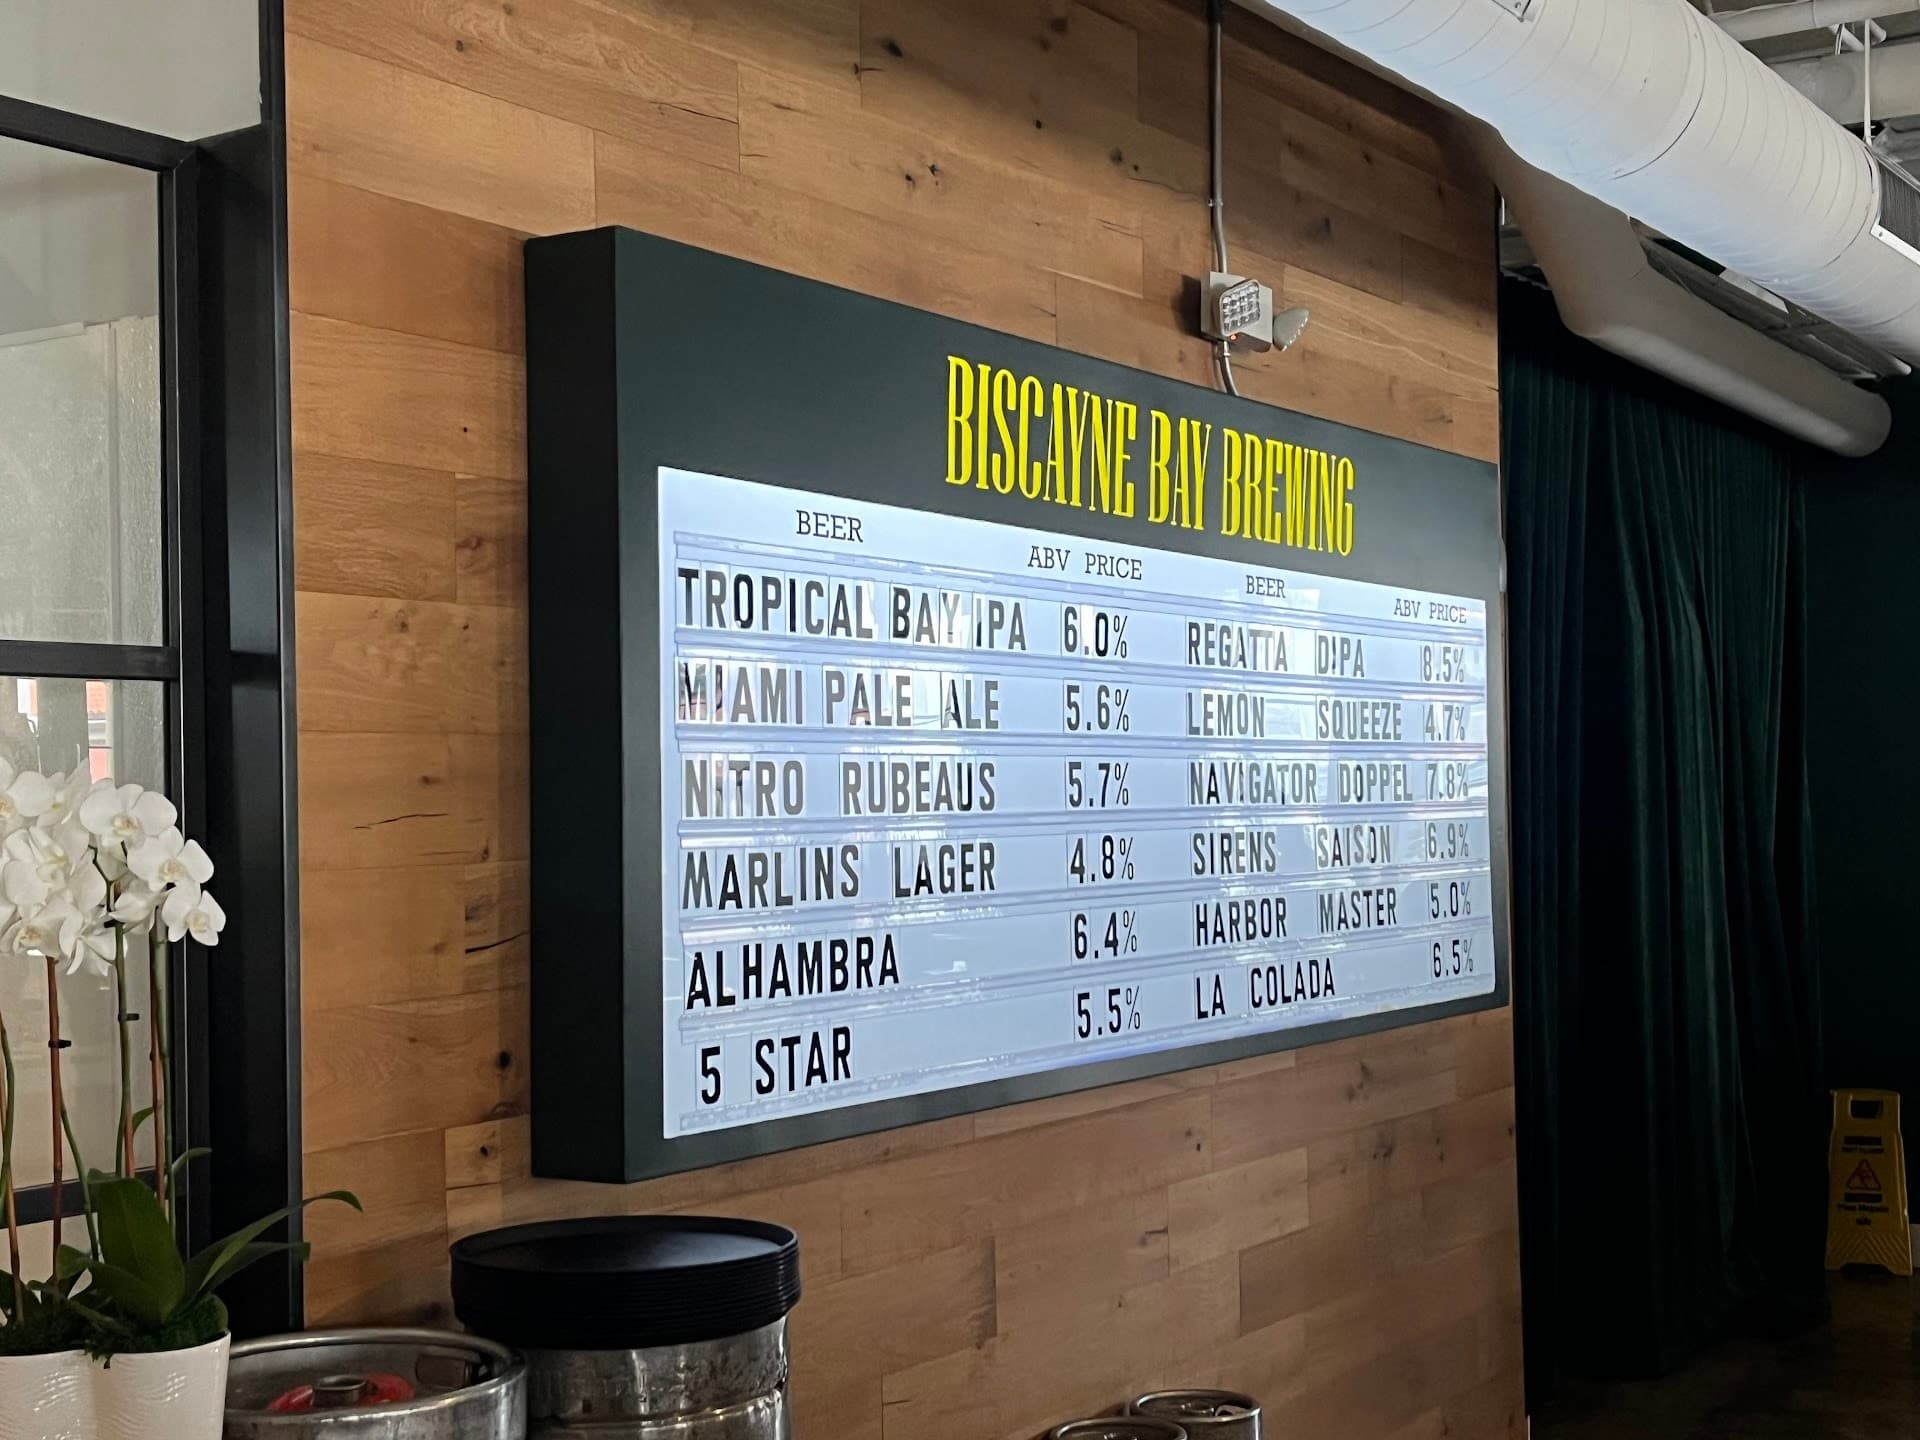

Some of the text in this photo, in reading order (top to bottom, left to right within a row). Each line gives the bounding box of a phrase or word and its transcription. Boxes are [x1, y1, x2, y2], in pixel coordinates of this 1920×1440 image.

[946, 355, 1355, 557] BISCAYNE BAY BREWING
[796, 509, 864, 543] BEER
[1027, 545, 1142, 581] ABV PRICE
[1245, 574, 1286, 599] BEER
[678, 567, 1128, 659] TROPICAL BAY IPA 6.0%
[1394, 597, 1467, 624] ABV PRICE
[1188, 621, 1464, 683] REGATTA DIPA 8.5%
[679, 662, 1129, 732] MIAMI PALE ALE 5.6%
[1187, 692, 1465, 742] LEMON SQUEEZE 4.7%
[685, 759, 1129, 818] NITRO RUBEAUS 5.7%
[1190, 762, 1468, 807] NAVIGATOR DOPPEL 7.8%
[683, 835, 1134, 911] MARLINS LAGER 4.8%
[1193, 822, 1469, 876] SIRENS SAISON 6.9%
[1196, 880, 1471, 947] HARBOR MASTER 5.0%
[686, 910, 1138, 1011] ALHAMBRA 6.4%
[1196, 938, 1473, 1020] LA COLADA 6.5%
[701, 985, 1141, 1105] 5 STAR 5.5%
